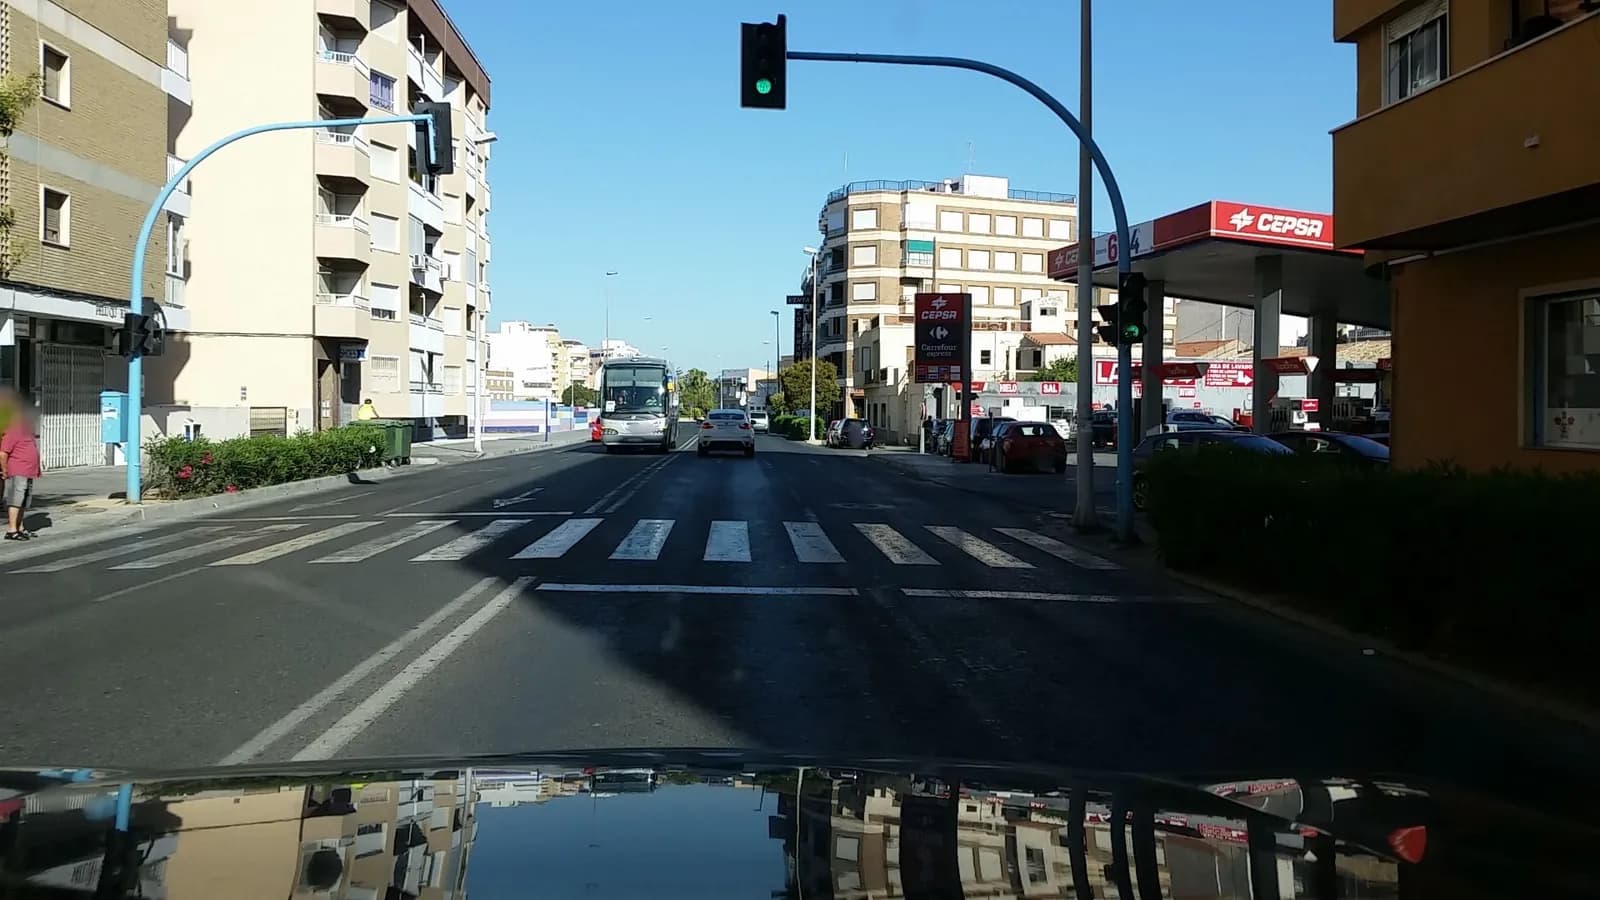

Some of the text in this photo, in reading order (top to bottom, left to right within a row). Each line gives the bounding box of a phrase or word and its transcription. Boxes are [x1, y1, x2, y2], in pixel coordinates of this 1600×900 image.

[1257, 213, 1323, 238] CEPSA
[921, 310, 958, 320] CEPSA
[1043, 384, 1058, 393] SAL
